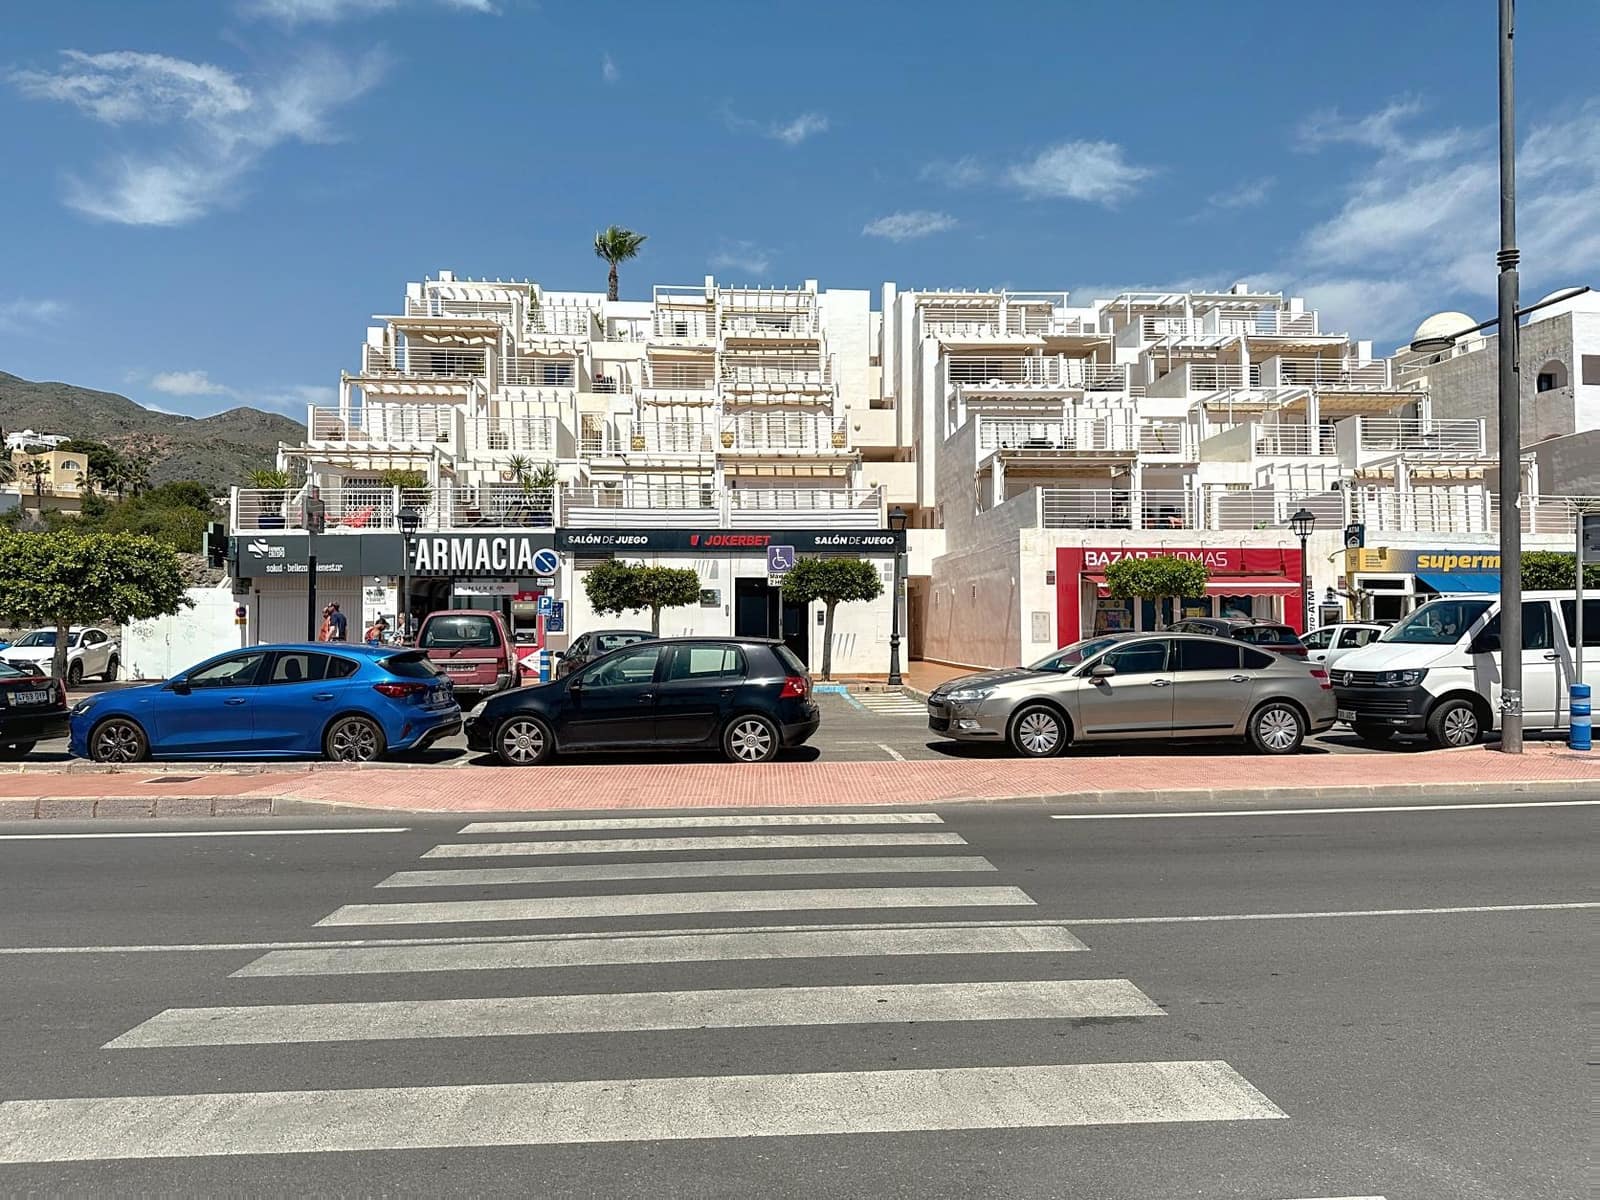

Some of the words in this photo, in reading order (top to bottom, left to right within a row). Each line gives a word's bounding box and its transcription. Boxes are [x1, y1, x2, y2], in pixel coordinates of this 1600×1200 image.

[567, 533, 601, 544] SALÓN
[602, 535, 615, 544] DE
[615, 535, 648, 544] JUEGO
[704, 535, 771, 546] JOKERBET
[814, 534, 848, 545] SALÓN
[849, 536, 861, 545] DE
[861, 536, 894, 545] JUEGO
[316, 563, 343, 572] ienestar
[1417, 554, 1501, 572] superm
[541, 598, 550, 608] P
